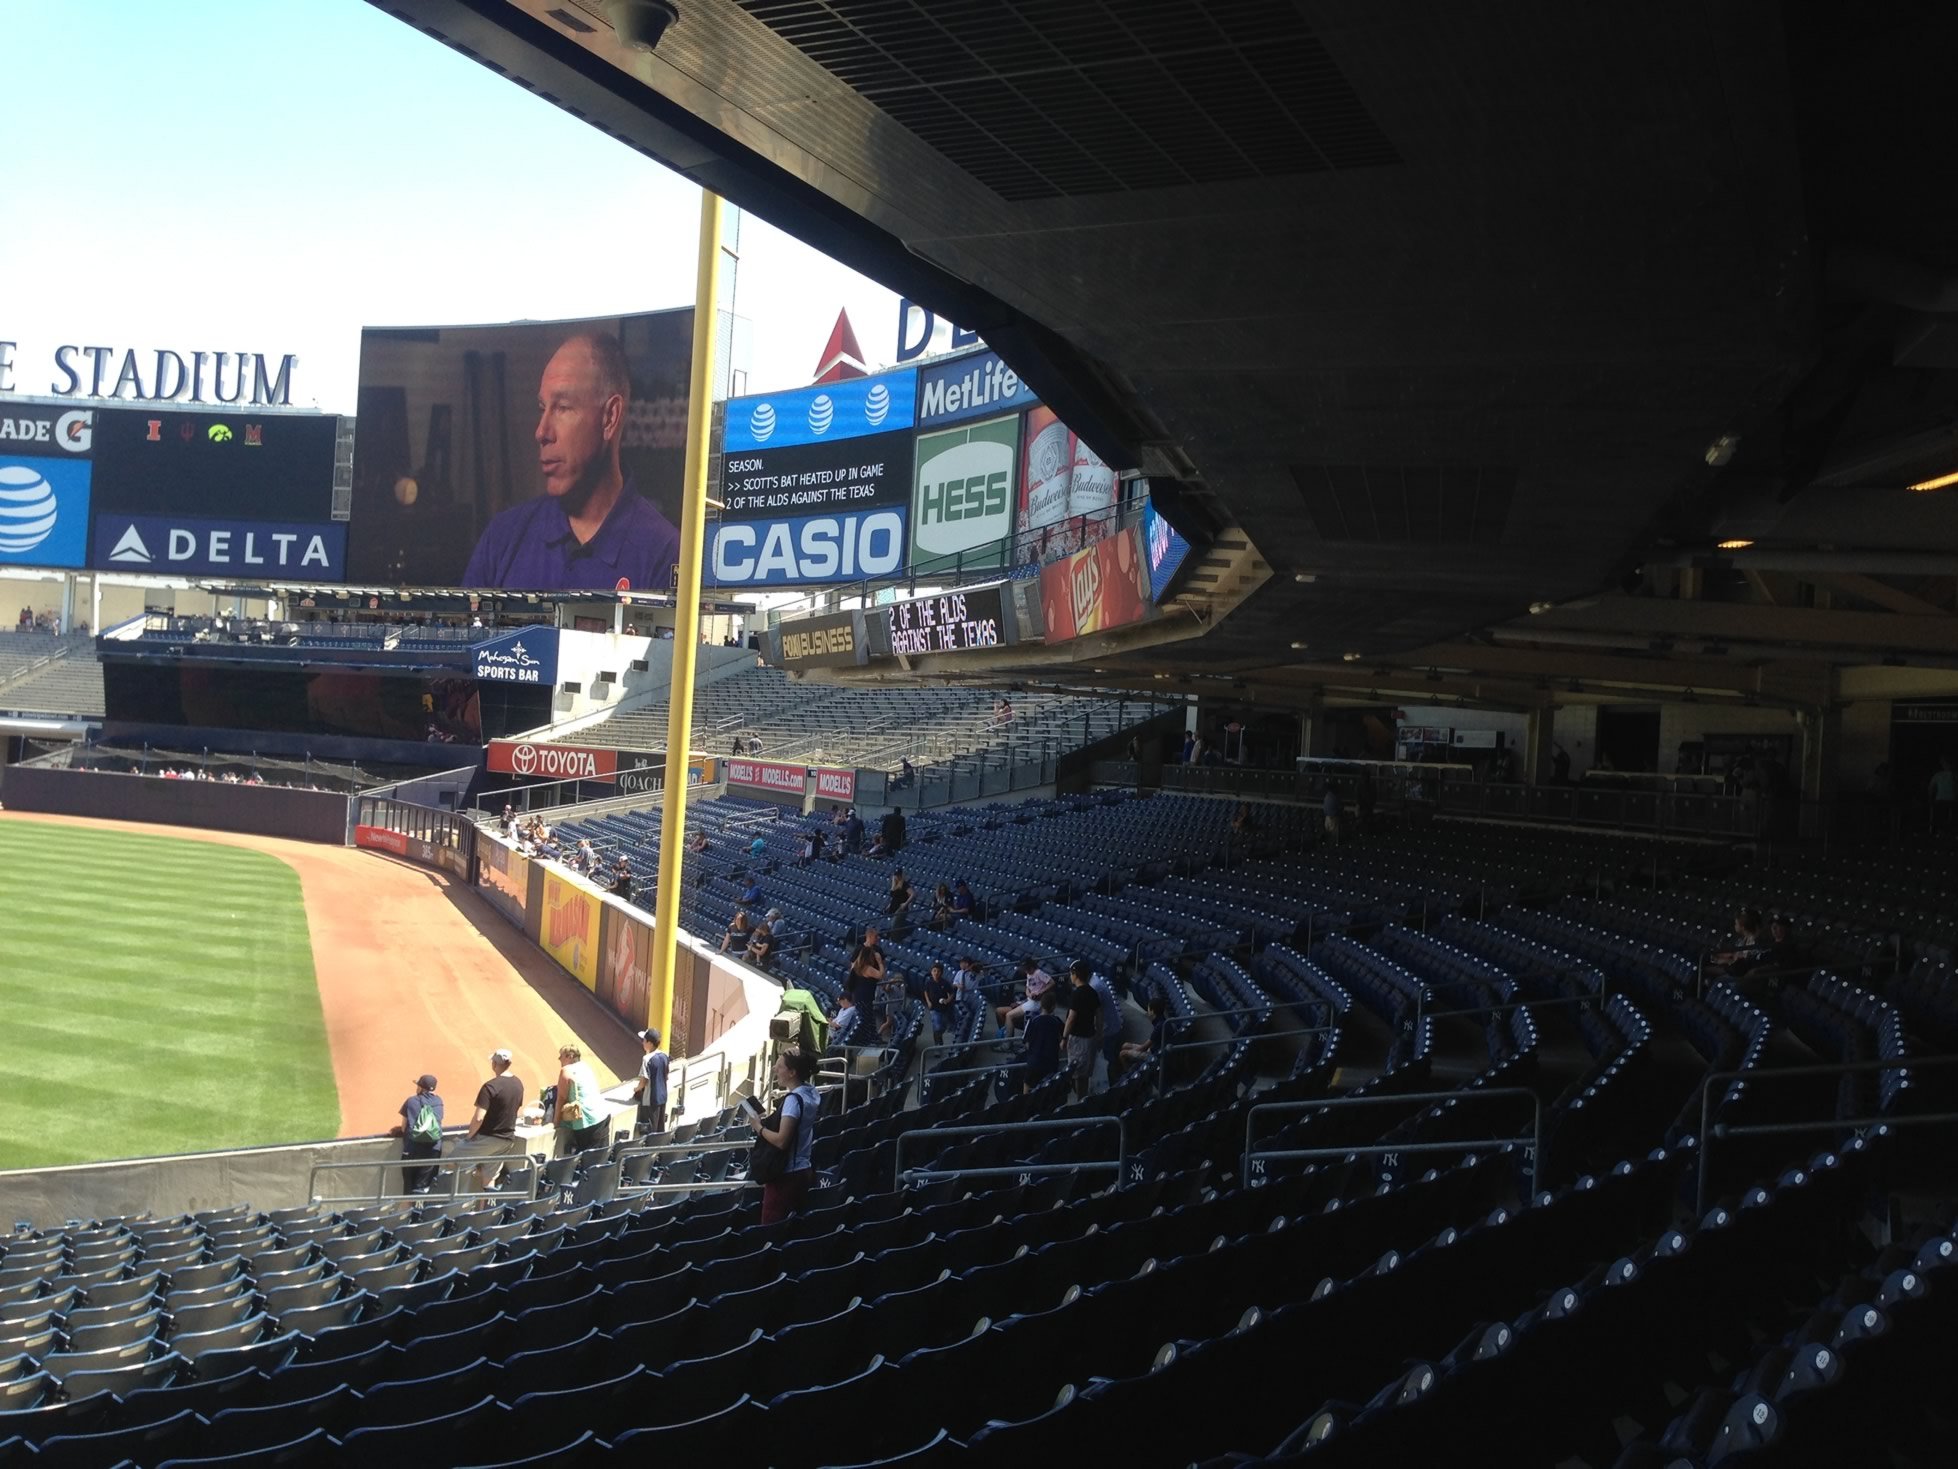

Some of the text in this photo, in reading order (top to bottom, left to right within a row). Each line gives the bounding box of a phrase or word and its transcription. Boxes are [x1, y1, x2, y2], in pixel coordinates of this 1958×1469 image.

[51, 345, 297, 405] STADIUM
[920, 359, 1019, 418] MetLife
[728, 459, 764, 474] SEASON.
[743, 476, 779, 491] SCOTT'S
[781, 475, 797, 488] BAT
[799, 470, 833, 486] HEATED
[835, 468, 846, 483] UP
[848, 467, 858, 480] IN
[860, 463, 884, 478] GAME
[726, 483, 875, 510] 2 OF THE ALDS AGAINST THE TEXAS
[922, 472, 1007, 524] HESS
[167, 528, 330, 567] DELTA
[711, 512, 903, 582] CASIO
[888, 594, 967, 632] 2 OF THE ALDS
[801, 626, 853, 656] BUSINESS
[891, 618, 998, 655] AGAINST THE TEXAS
[477, 665, 539, 682] SPORTS BAR
[520, 654, 540, 666] Sun
[539, 750, 596, 776] TOYOTA
[620, 774, 662, 791] COACH
[762, 767, 803, 789] MODELLS.com
[819, 773, 851, 794] MODELL'S
